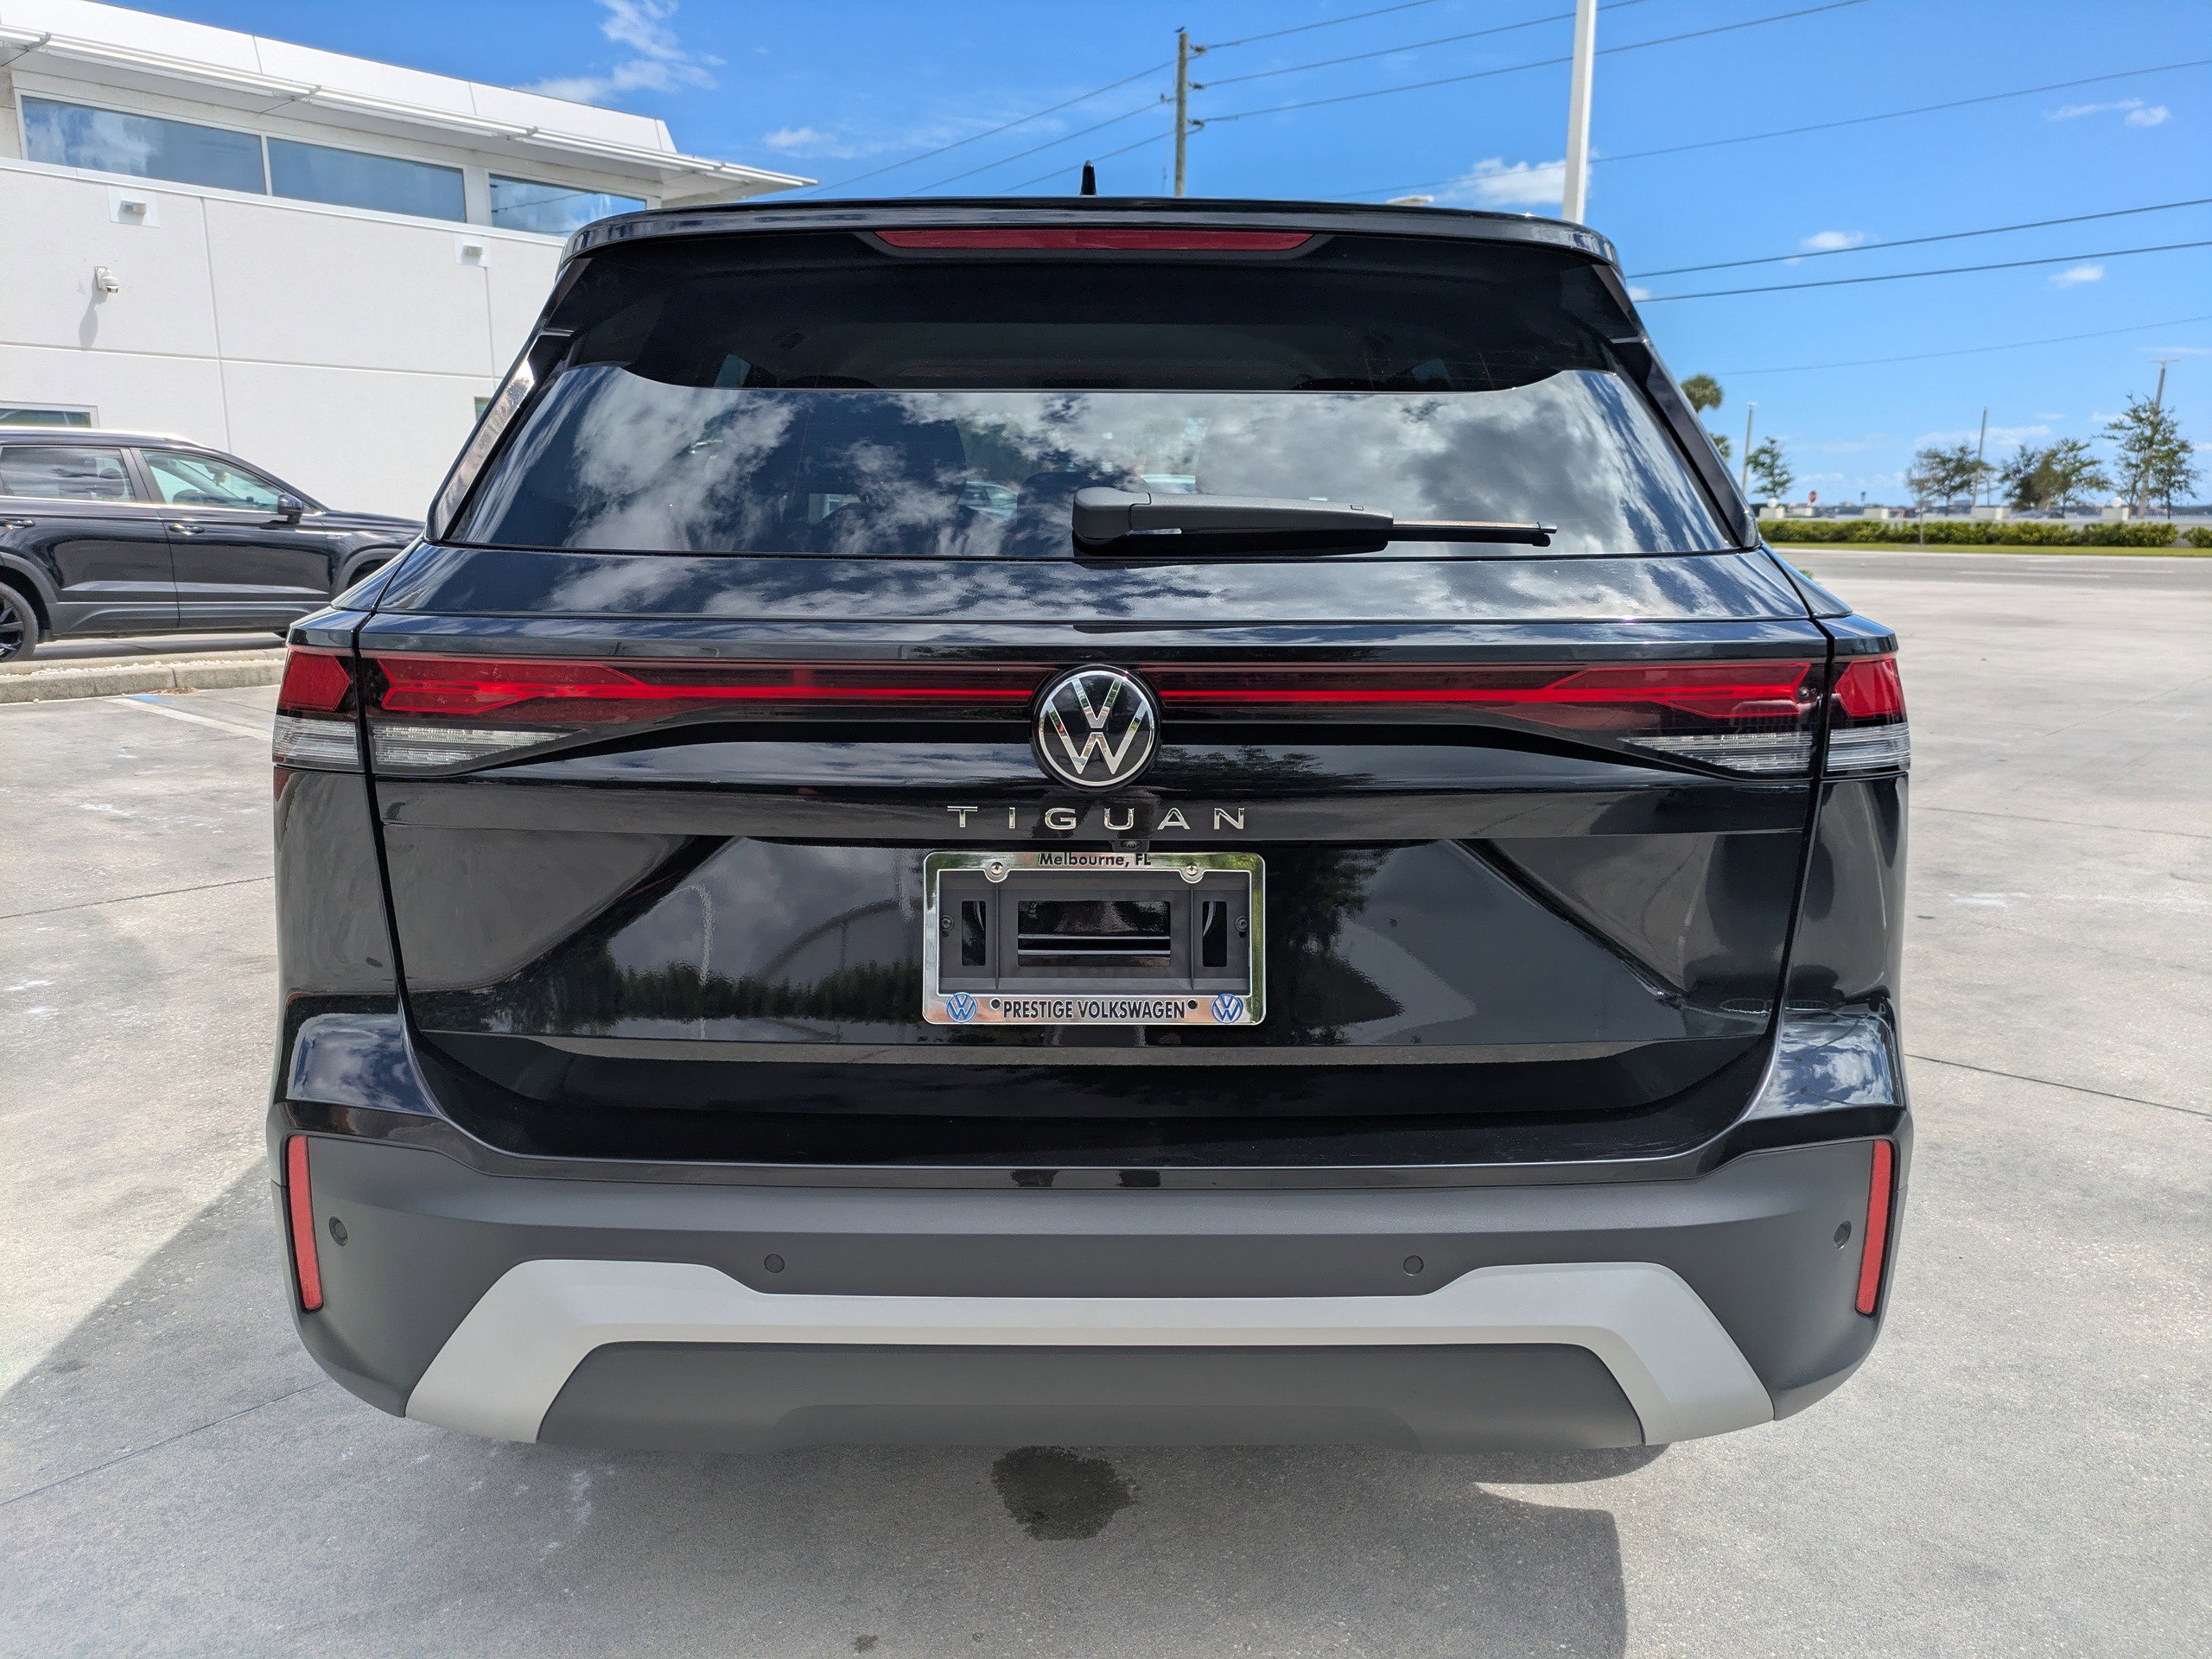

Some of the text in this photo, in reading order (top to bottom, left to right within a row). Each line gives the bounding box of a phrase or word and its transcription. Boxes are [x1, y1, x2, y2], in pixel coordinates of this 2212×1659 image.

[947, 805, 1245, 830] TIGUAN
[1039, 852, 1152, 868] Melbourne, FL
[1002, 1000, 1185, 1020] PRESTIGE VOLKSWAGEN
